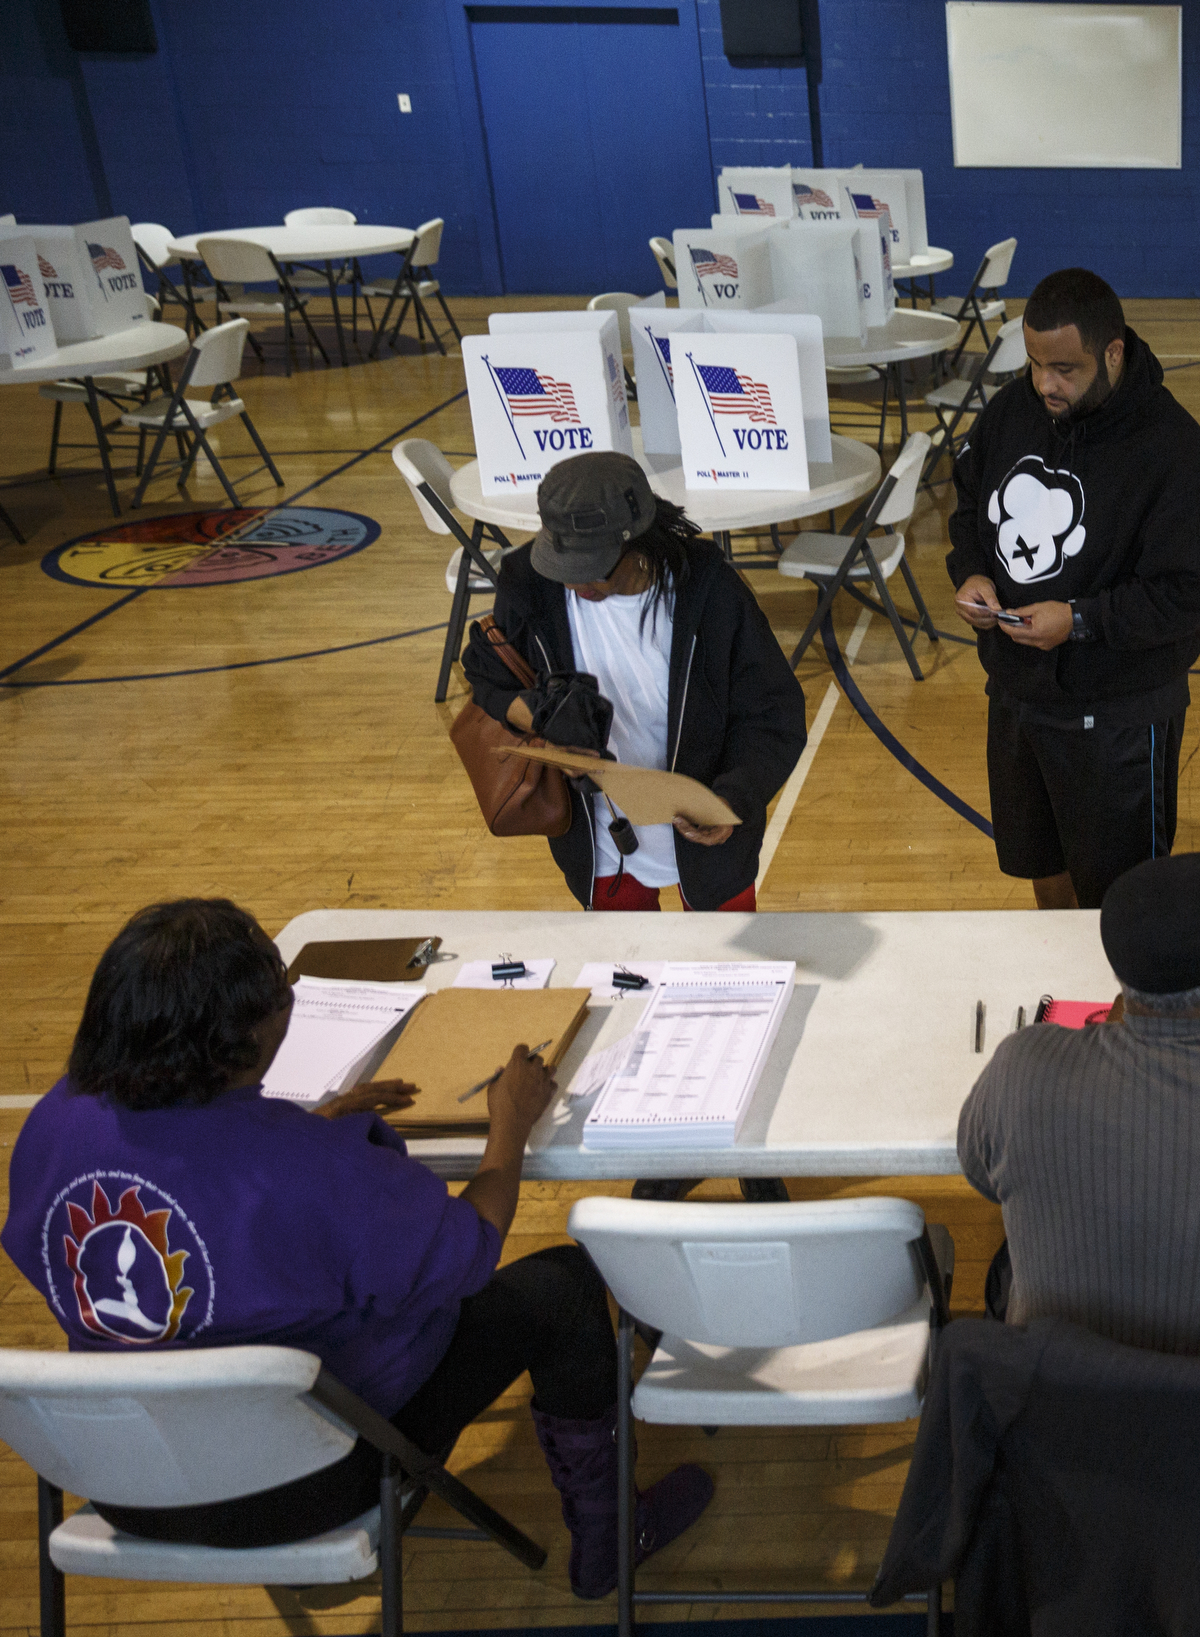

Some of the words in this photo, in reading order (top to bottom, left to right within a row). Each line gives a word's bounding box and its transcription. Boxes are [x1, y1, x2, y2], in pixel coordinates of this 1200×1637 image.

[108, 272, 138, 293] VOTE
[22, 308, 46, 330] VOTE
[533, 427, 594, 452] VOTE
[733, 428, 789, 451] VOTE
[493, 474, 510, 484] POLL
[516, 472, 542, 482] MASTER
[696, 470, 711, 478] POLL
[717, 470, 741, 479] MASTER
